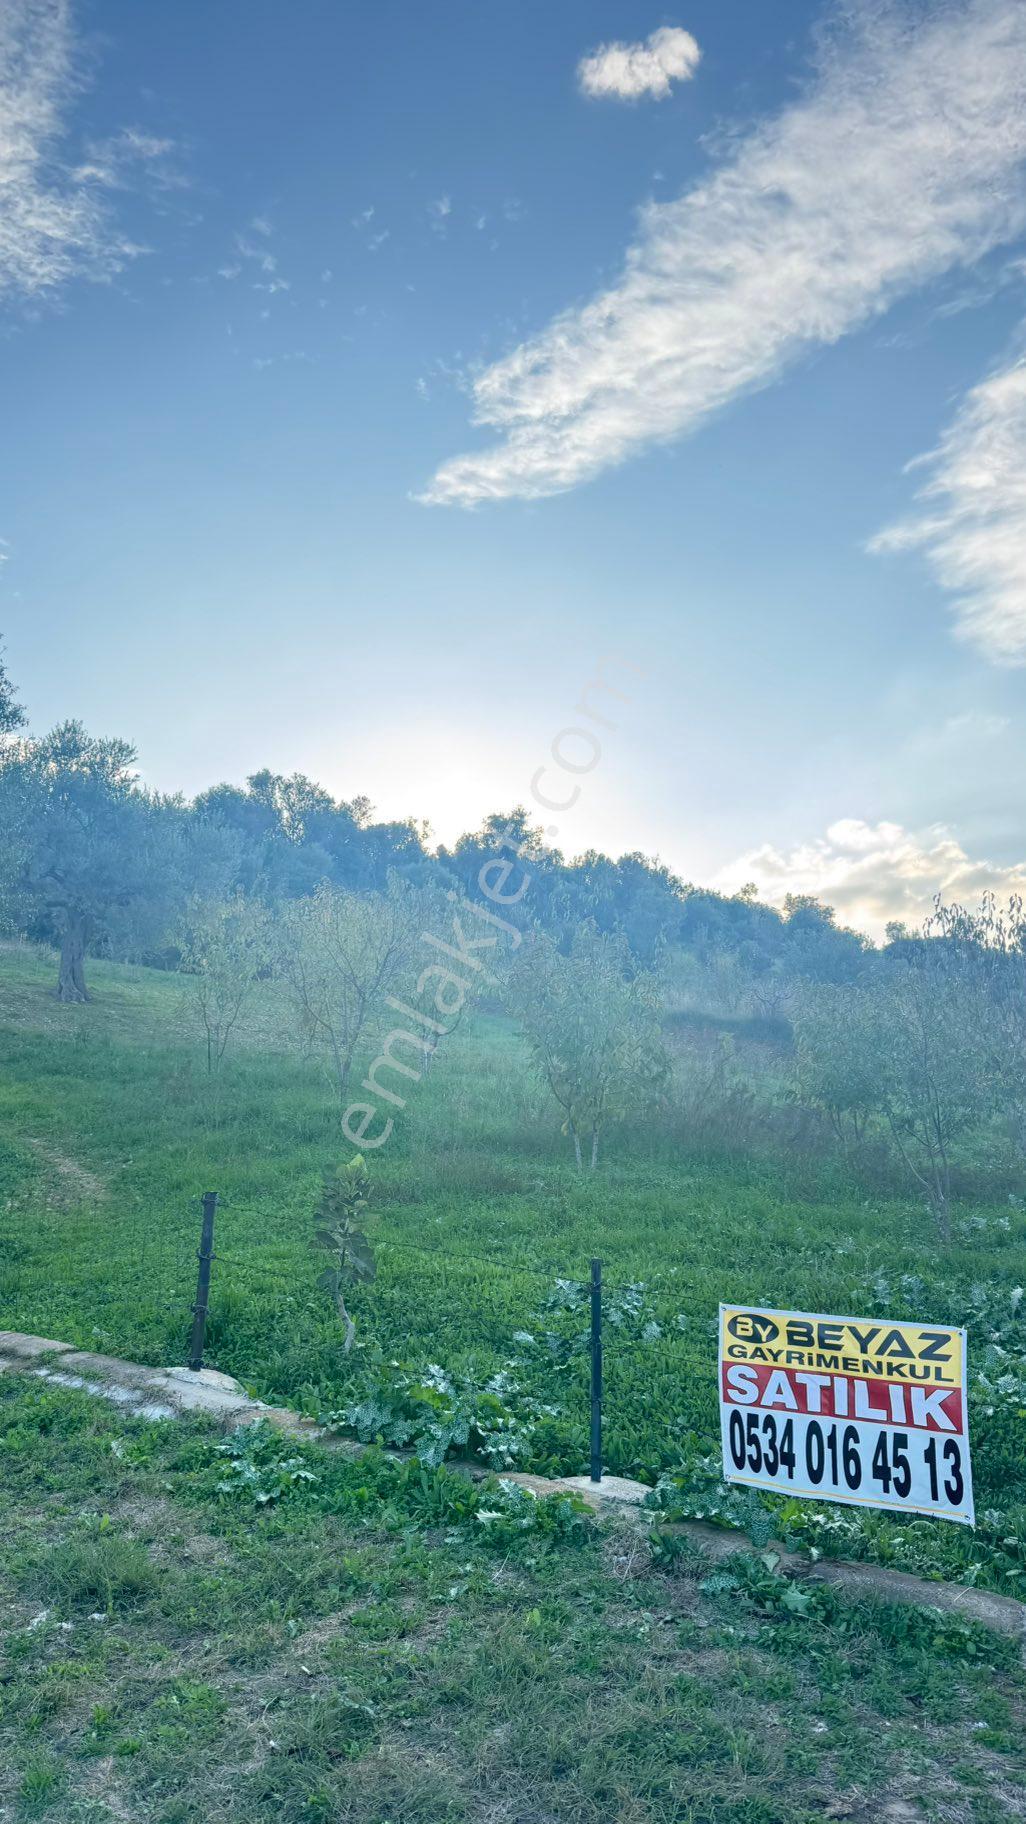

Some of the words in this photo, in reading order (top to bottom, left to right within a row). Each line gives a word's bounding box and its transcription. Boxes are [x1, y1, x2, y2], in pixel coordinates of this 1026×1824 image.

[786, 1320, 952, 1362] BEYAZ
[726, 1364, 957, 1431] SATILIK
[730, 1409, 795, 1479] 0534
[805, 1419, 862, 1490] 016
[872, 1430, 912, 1498] 45
[924, 1437, 964, 1506] 13
